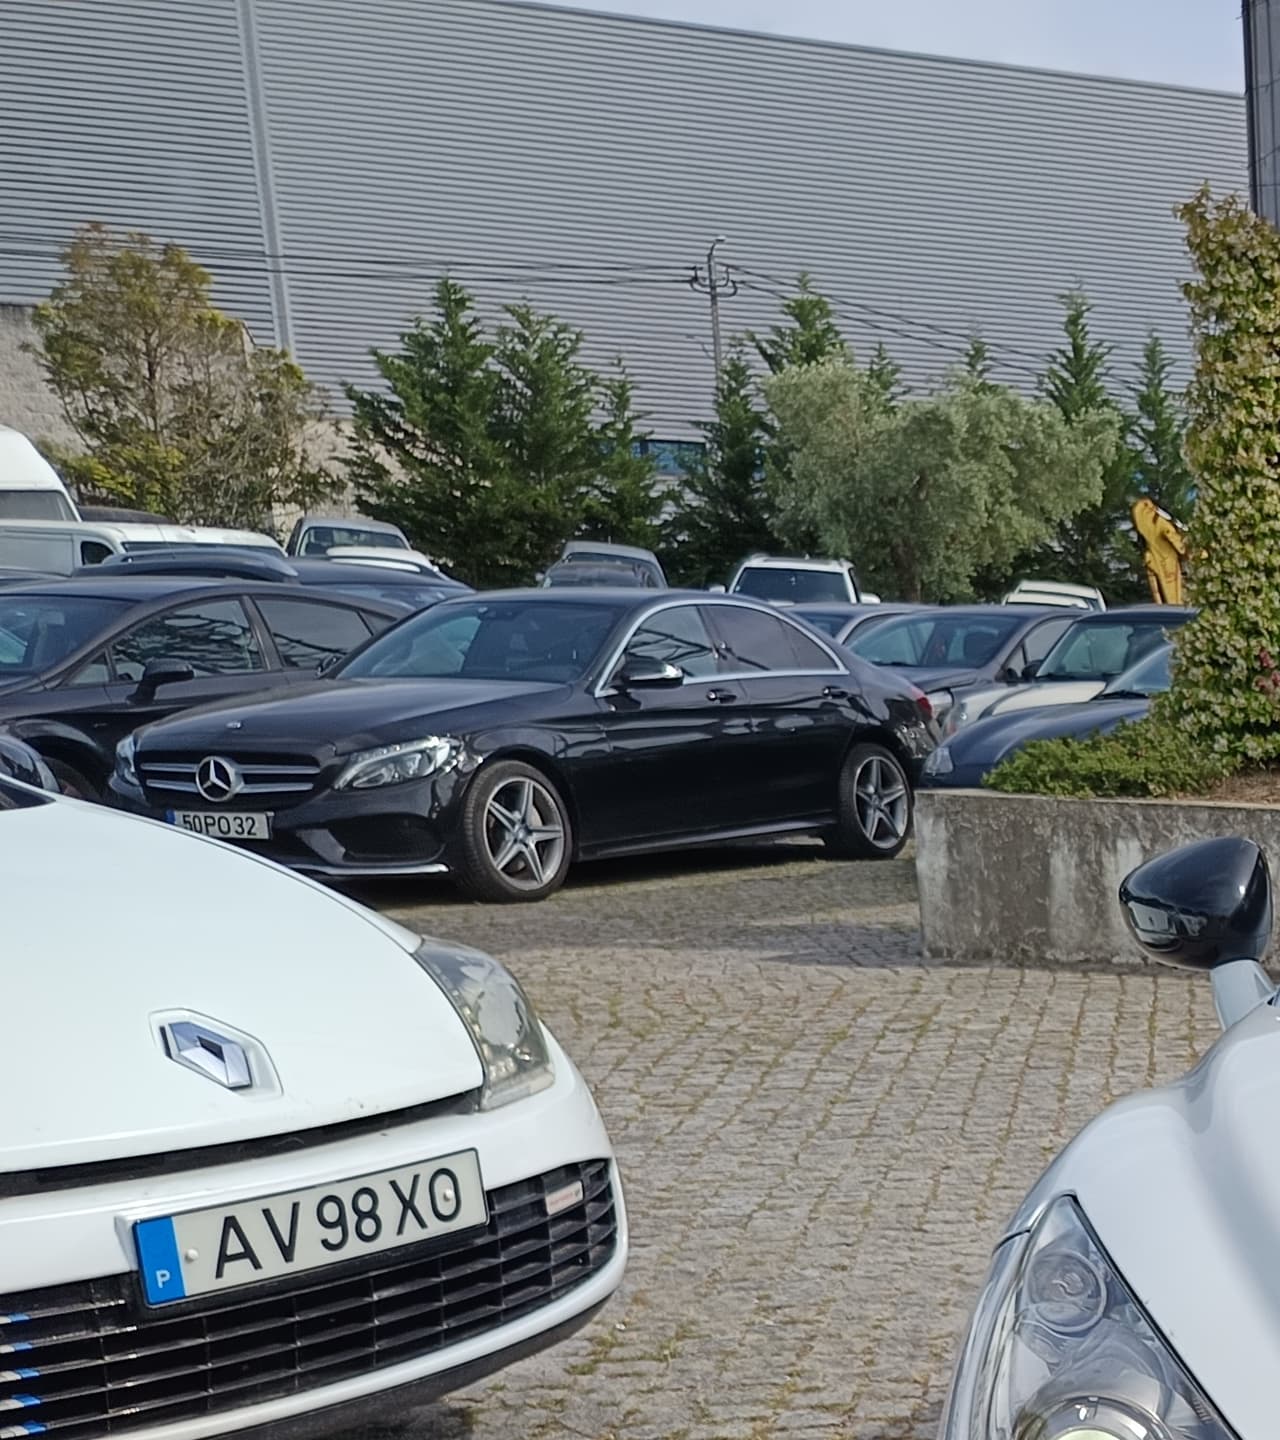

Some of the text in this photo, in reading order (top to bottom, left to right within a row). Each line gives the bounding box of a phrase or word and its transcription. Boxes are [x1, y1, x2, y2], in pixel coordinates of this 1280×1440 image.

[182, 813, 257, 836] 50PO32
[215, 1167, 462, 1279] AV98XO
[156, 1269, 171, 1289] P
